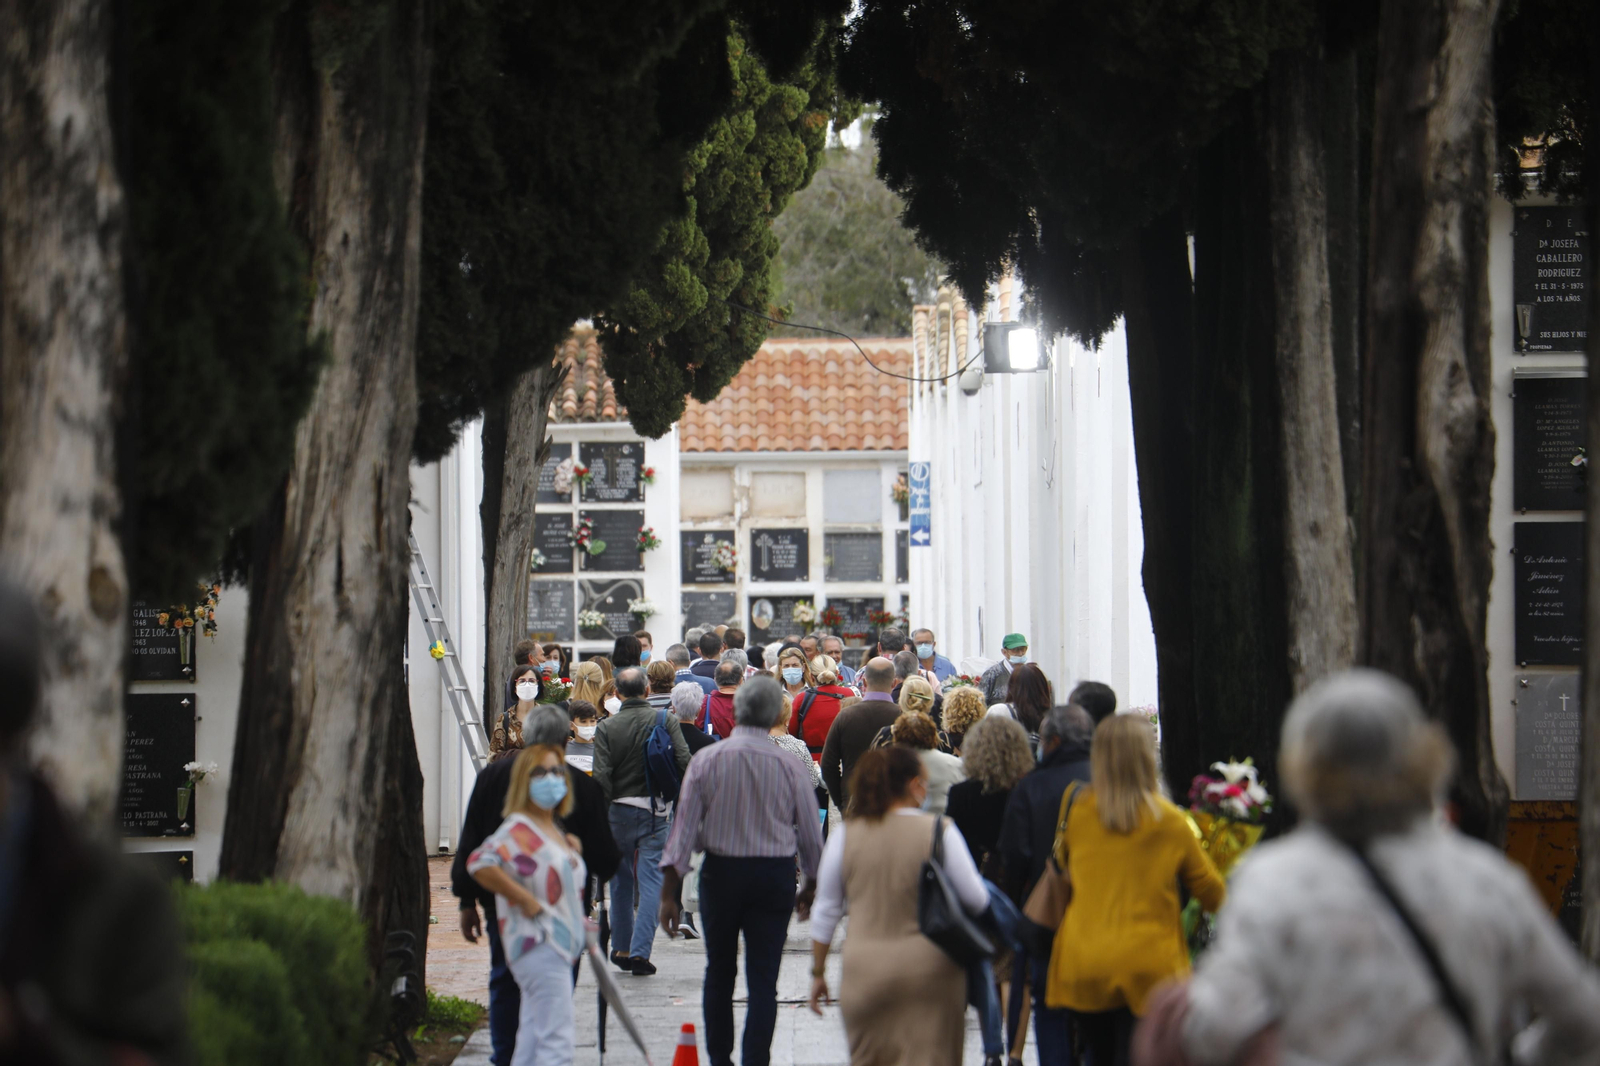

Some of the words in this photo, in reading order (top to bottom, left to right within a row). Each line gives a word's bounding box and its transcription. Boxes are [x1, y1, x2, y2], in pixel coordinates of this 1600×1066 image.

[1551, 239, 1580, 249] JOSEFA
[1536, 253, 1583, 263] CABALLERO
[1537, 268, 1582, 278] RODRIGUEZ
[132, 628, 151, 638] LEZ
[140, 647, 148, 655] OS
[1553, 711, 1582, 720] DOLORE
[1534, 720, 1556, 728] COSTA
[130, 738, 155, 746] PEREZ
[1534, 744, 1556, 753] COSTA
[126, 764, 147, 772] RESA
[1534, 769, 1555, 777] COSTA
[135, 811, 168, 819] PASTRANA
